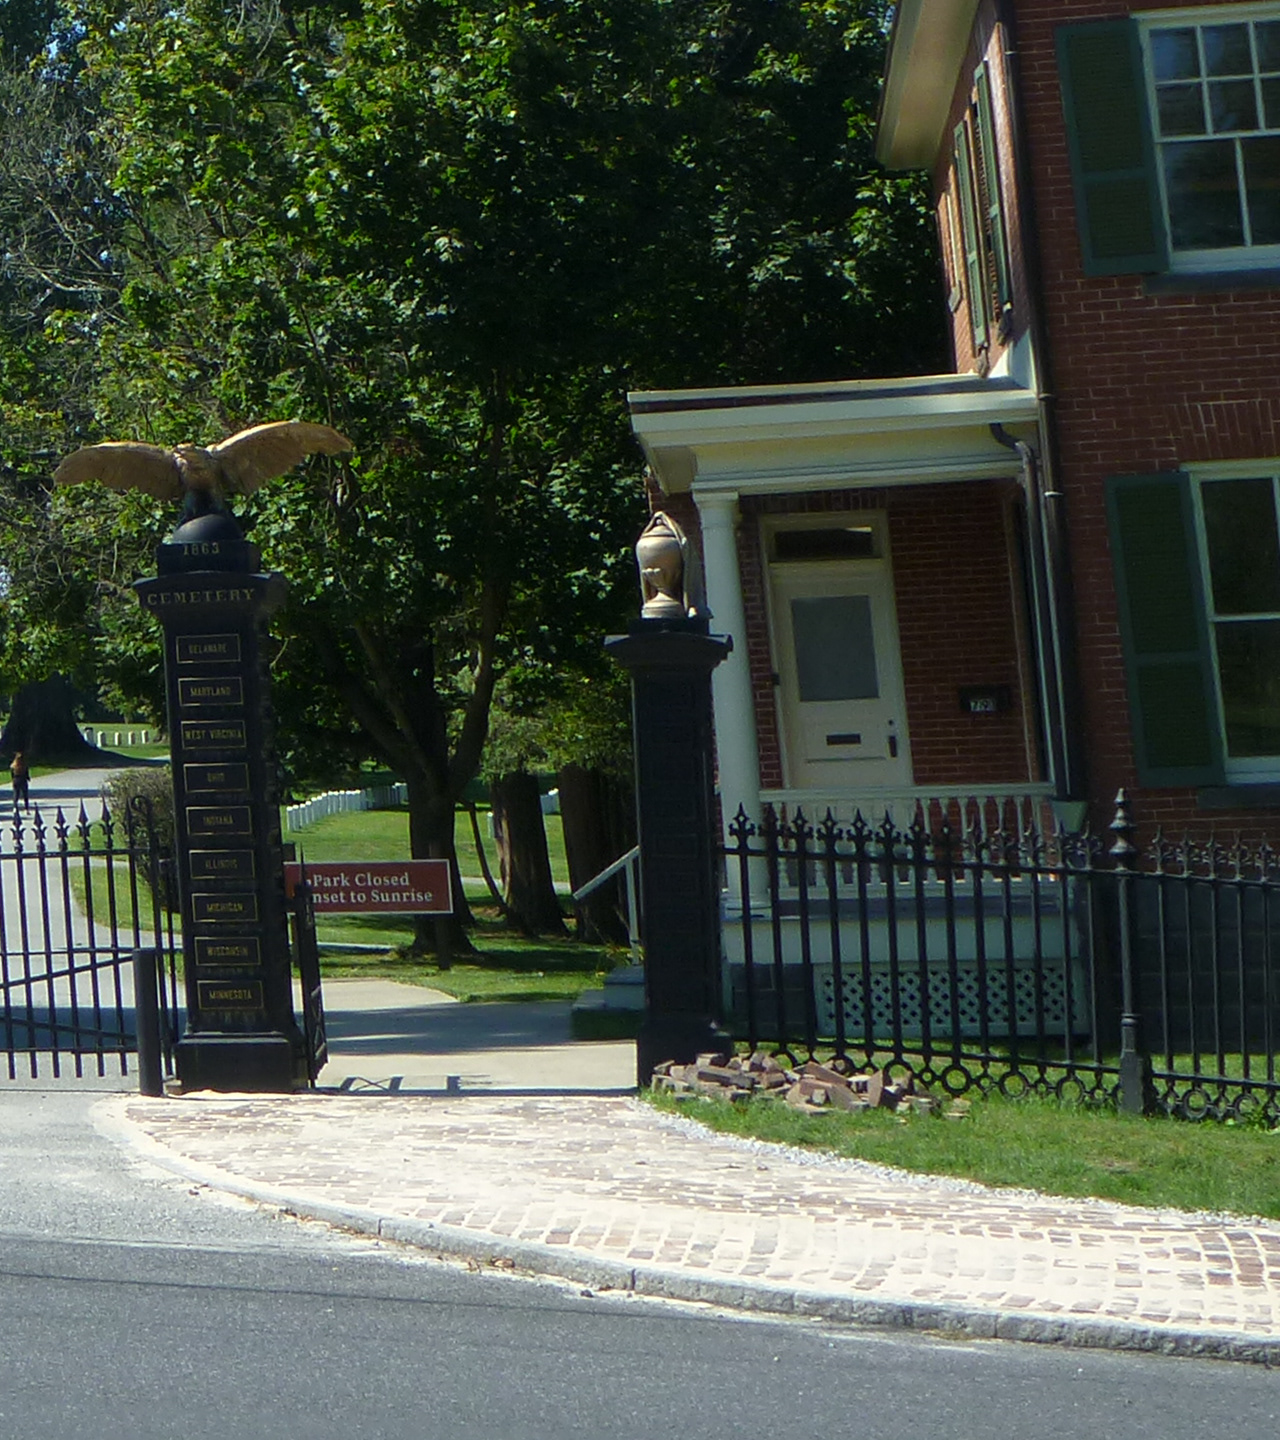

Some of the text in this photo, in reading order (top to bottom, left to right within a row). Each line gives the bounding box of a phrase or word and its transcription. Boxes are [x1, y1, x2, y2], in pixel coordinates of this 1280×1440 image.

[183, 542, 221, 556] 1863
[147, 587, 256, 607] CEMETERY
[190, 686, 232, 697] MARYLAND
[184, 729, 206, 741] WEST
[313, 872, 410, 887] Park Closed
[312, 888, 433, 903] nset to Sunrise
[209, 989, 253, 1001] MINNESOTA
